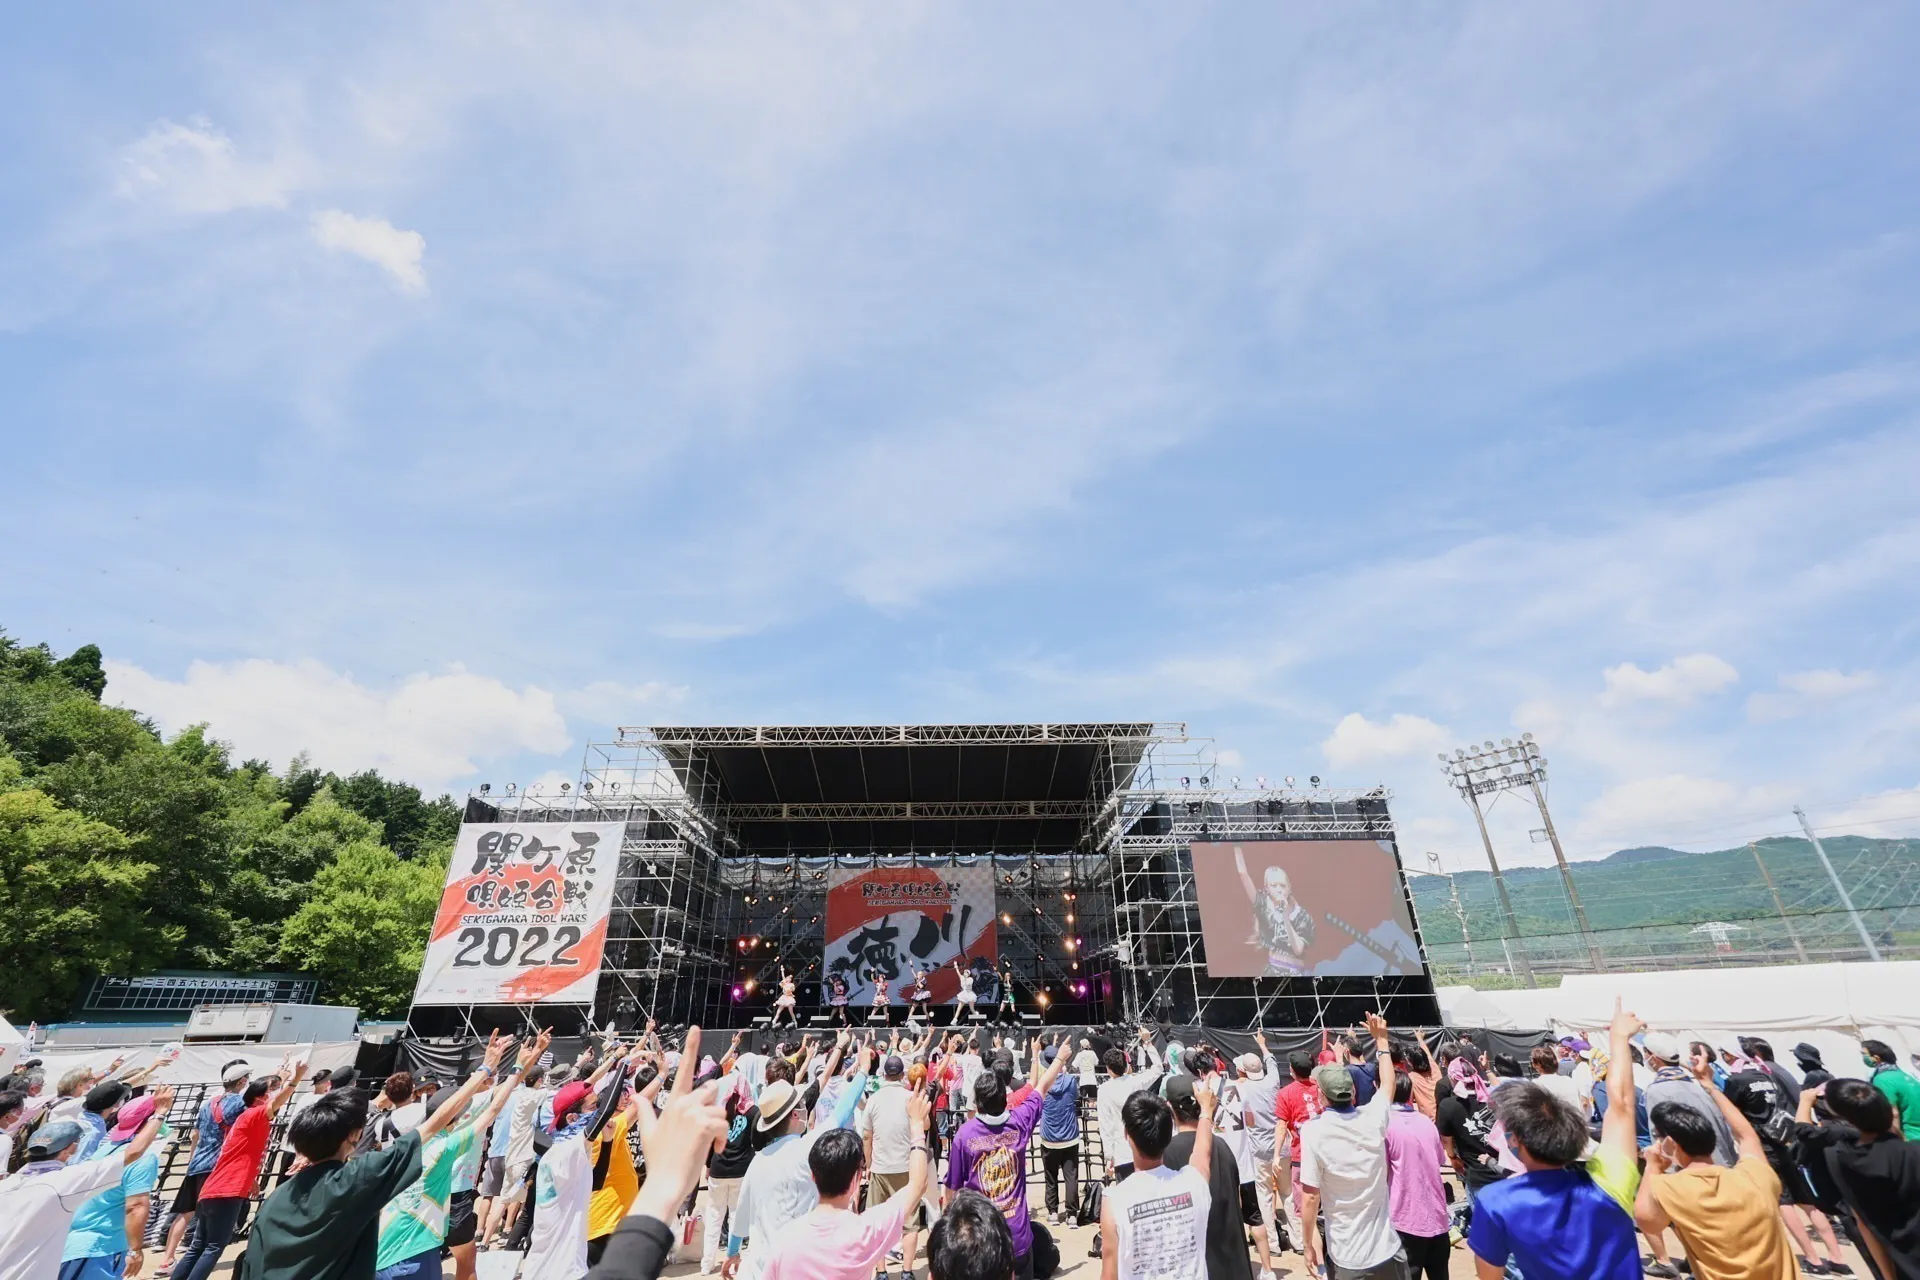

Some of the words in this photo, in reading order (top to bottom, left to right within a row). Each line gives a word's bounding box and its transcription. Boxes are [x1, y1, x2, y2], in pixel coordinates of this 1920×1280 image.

[461, 914, 528, 924] SEKIGAHARA
[531, 914, 557, 923] IDOL
[561, 913, 588, 923] WARS
[453, 926, 581, 967] 2022
[108, 977, 129, 986] チーム
[155, 978, 166, 986] 三
[178, 979, 187, 987] 五
[189, 979, 198, 987] 六
[200, 979, 208, 987] 七
[210, 980, 218, 988] 八
[220, 980, 228, 988] 九
[260, 981, 268, 989] 計
